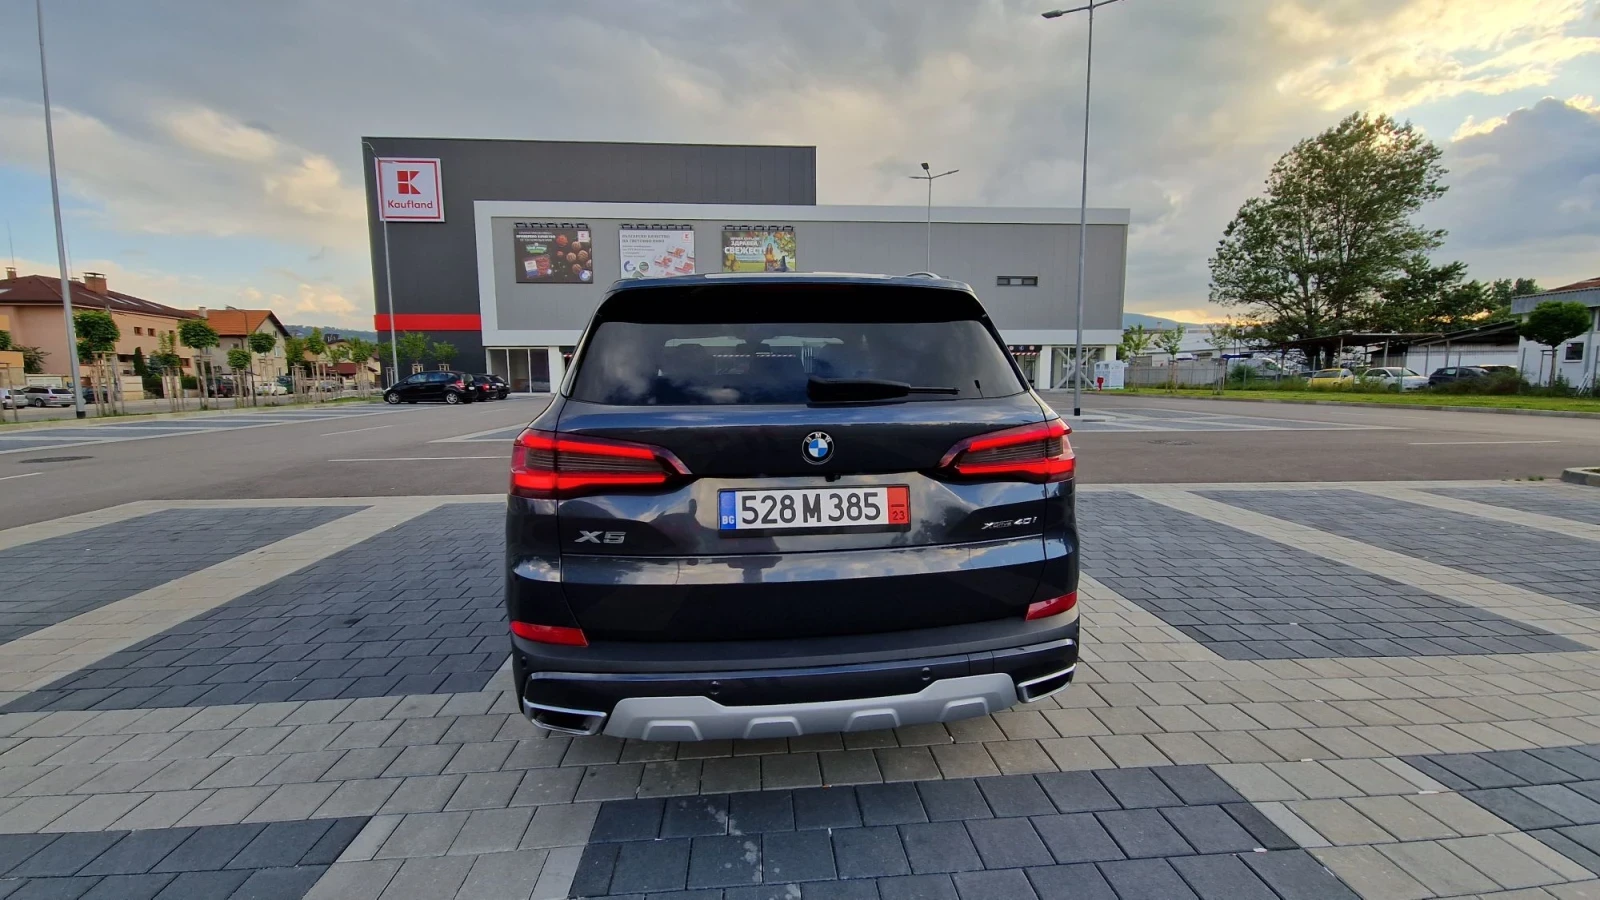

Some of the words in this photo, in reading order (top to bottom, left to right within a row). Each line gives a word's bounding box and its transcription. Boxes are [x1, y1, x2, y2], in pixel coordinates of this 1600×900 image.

[387, 199, 434, 209] Kaufland
[741, 494, 797, 525] 528
[802, 493, 822, 523] M
[828, 492, 881, 522] 385
[722, 515, 735, 525] BG
[892, 510, 906, 521] 23
[574, 530, 627, 544] X5
